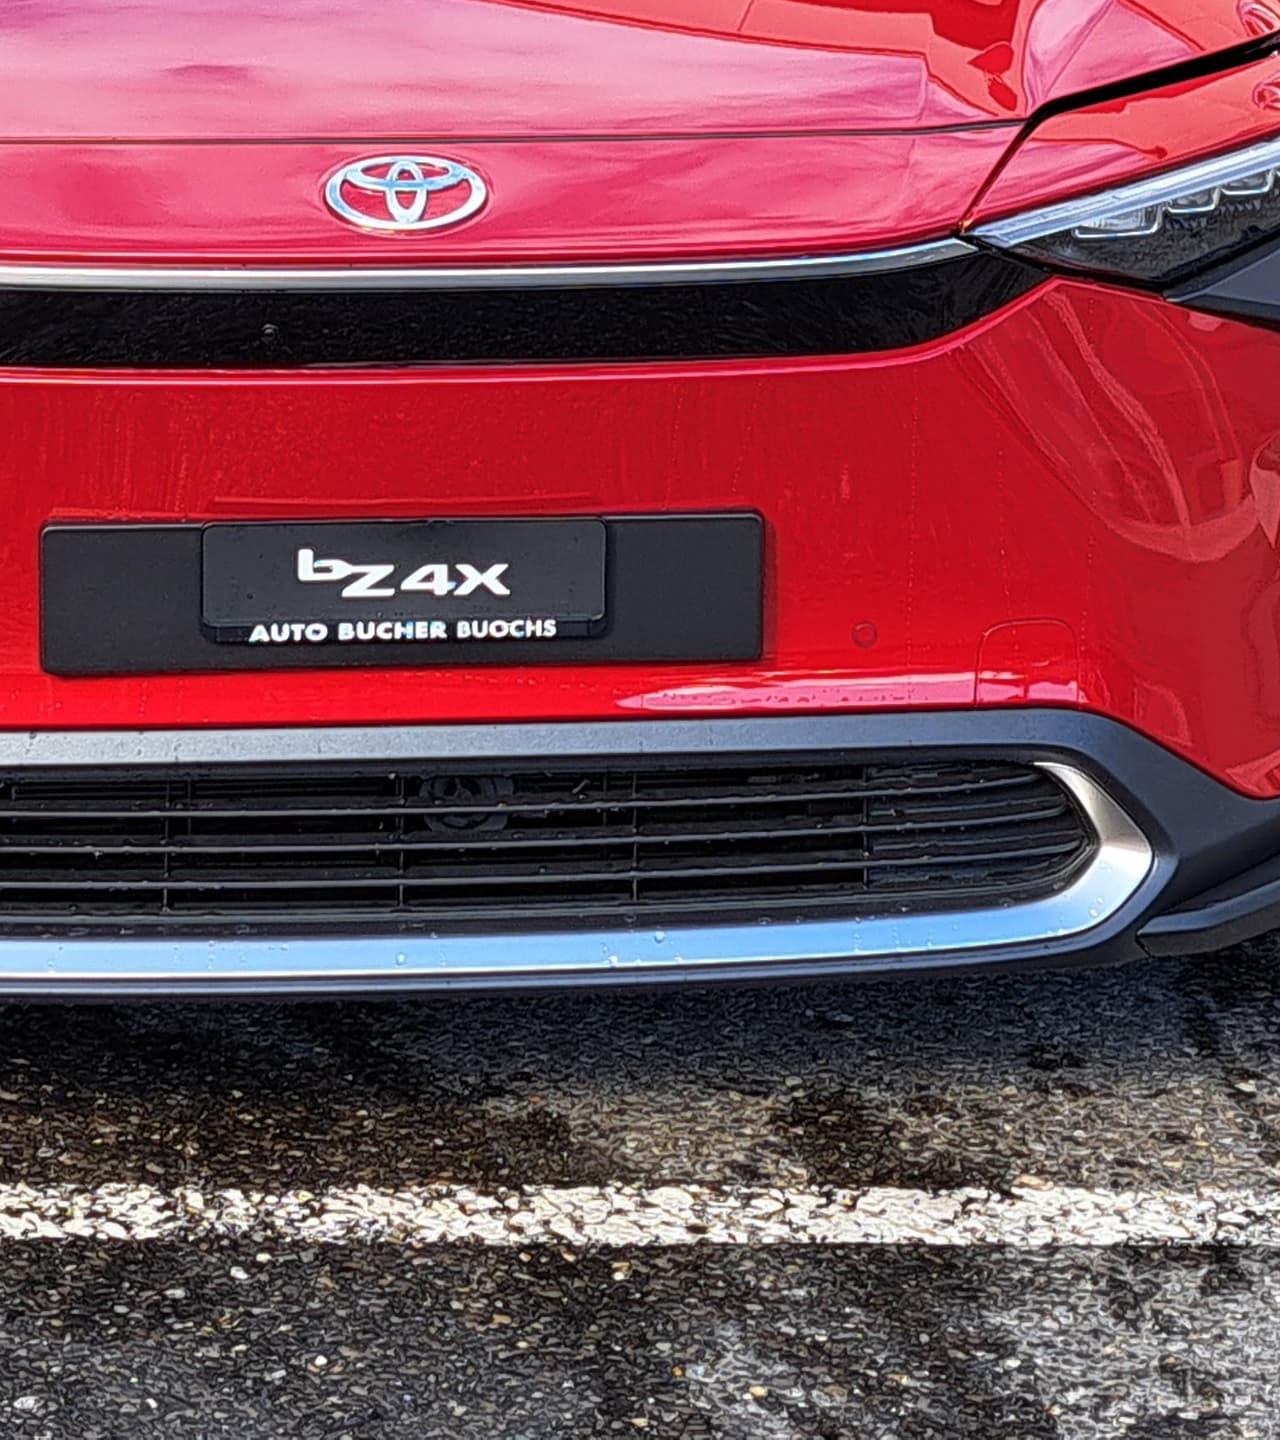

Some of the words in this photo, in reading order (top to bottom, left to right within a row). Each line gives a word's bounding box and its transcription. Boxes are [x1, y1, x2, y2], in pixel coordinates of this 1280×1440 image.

[248, 624, 328, 642] AUTO
[338, 621, 447, 641] BUCHER
[457, 619, 557, 638] BUOCHS
